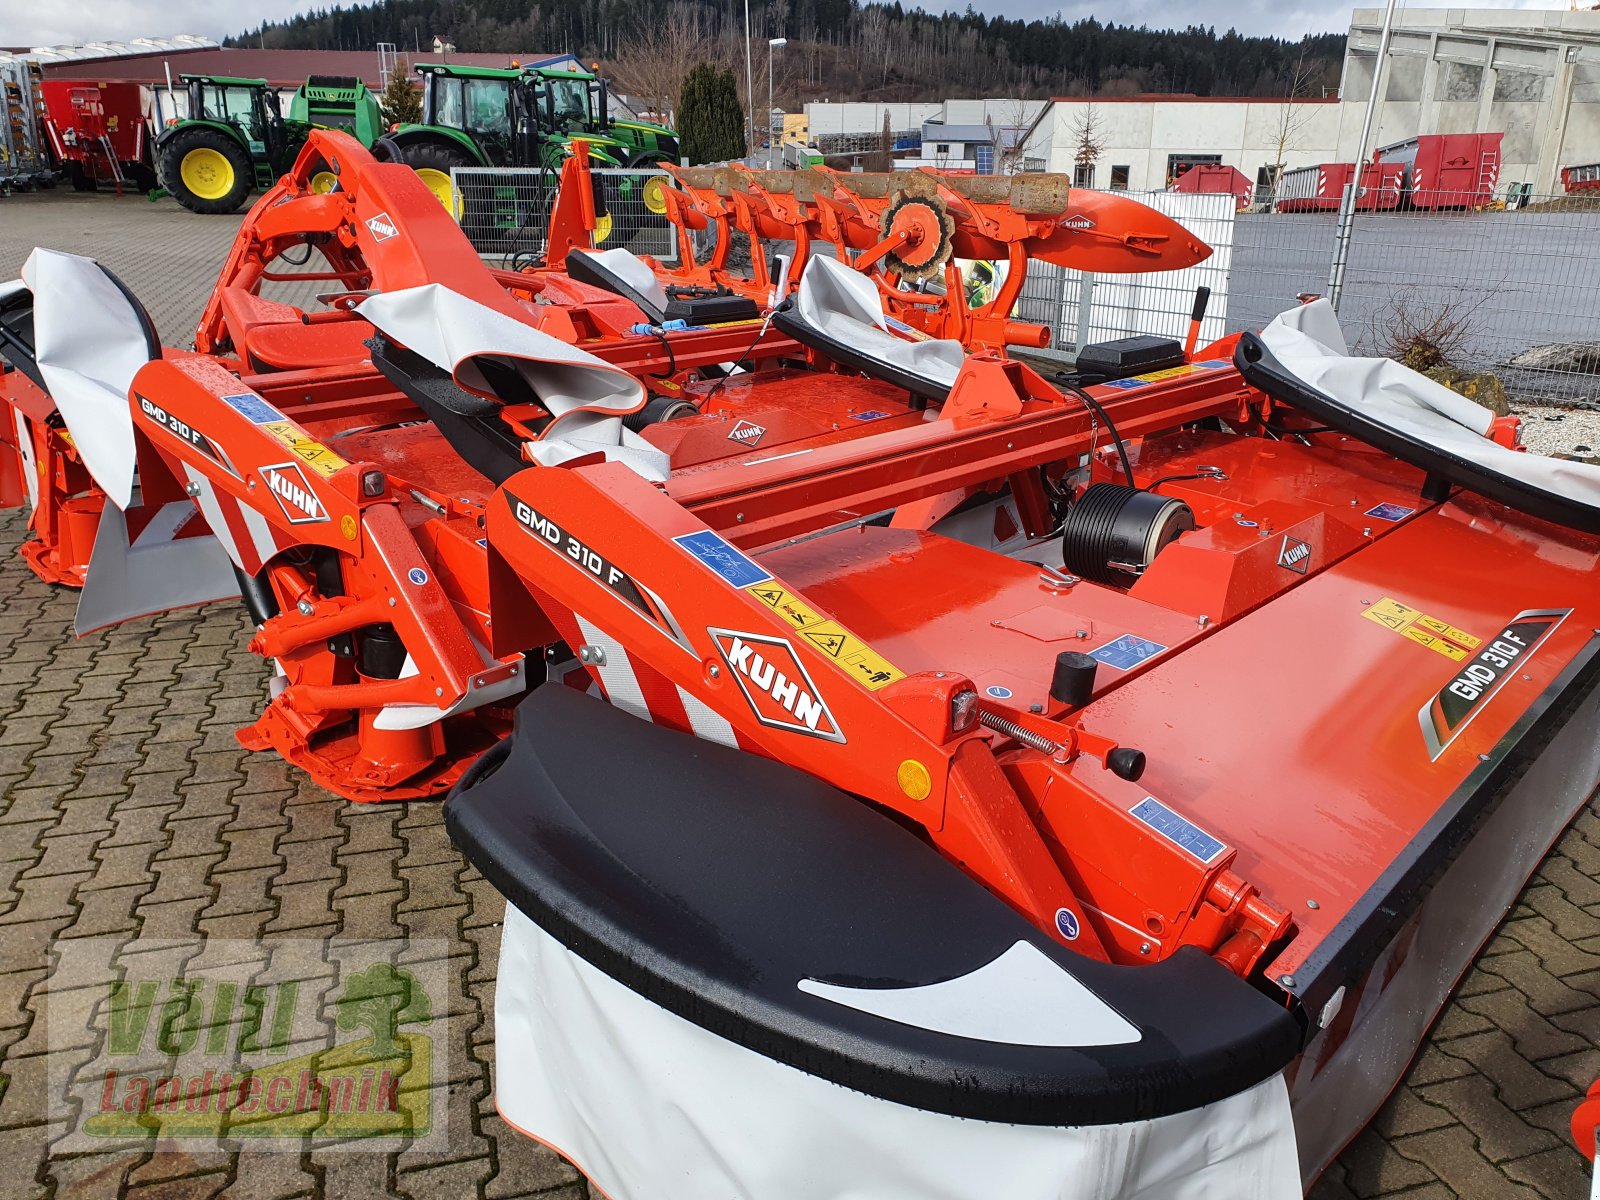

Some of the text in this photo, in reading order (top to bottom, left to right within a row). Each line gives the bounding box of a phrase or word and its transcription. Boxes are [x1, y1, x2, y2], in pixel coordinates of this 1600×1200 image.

[369, 219, 395, 237] KUHN
[1065, 221, 1091, 229] KUHN
[141, 398, 202, 444] GMD 310 F
[734, 426, 762, 441] KUHN
[269, 468, 320, 519] KUHN
[515, 501, 624, 586] GMD 310 F
[1282, 543, 1310, 566] KUHN
[727, 636, 824, 731] KUHN
[1449, 629, 1528, 702] GMD 310 F
